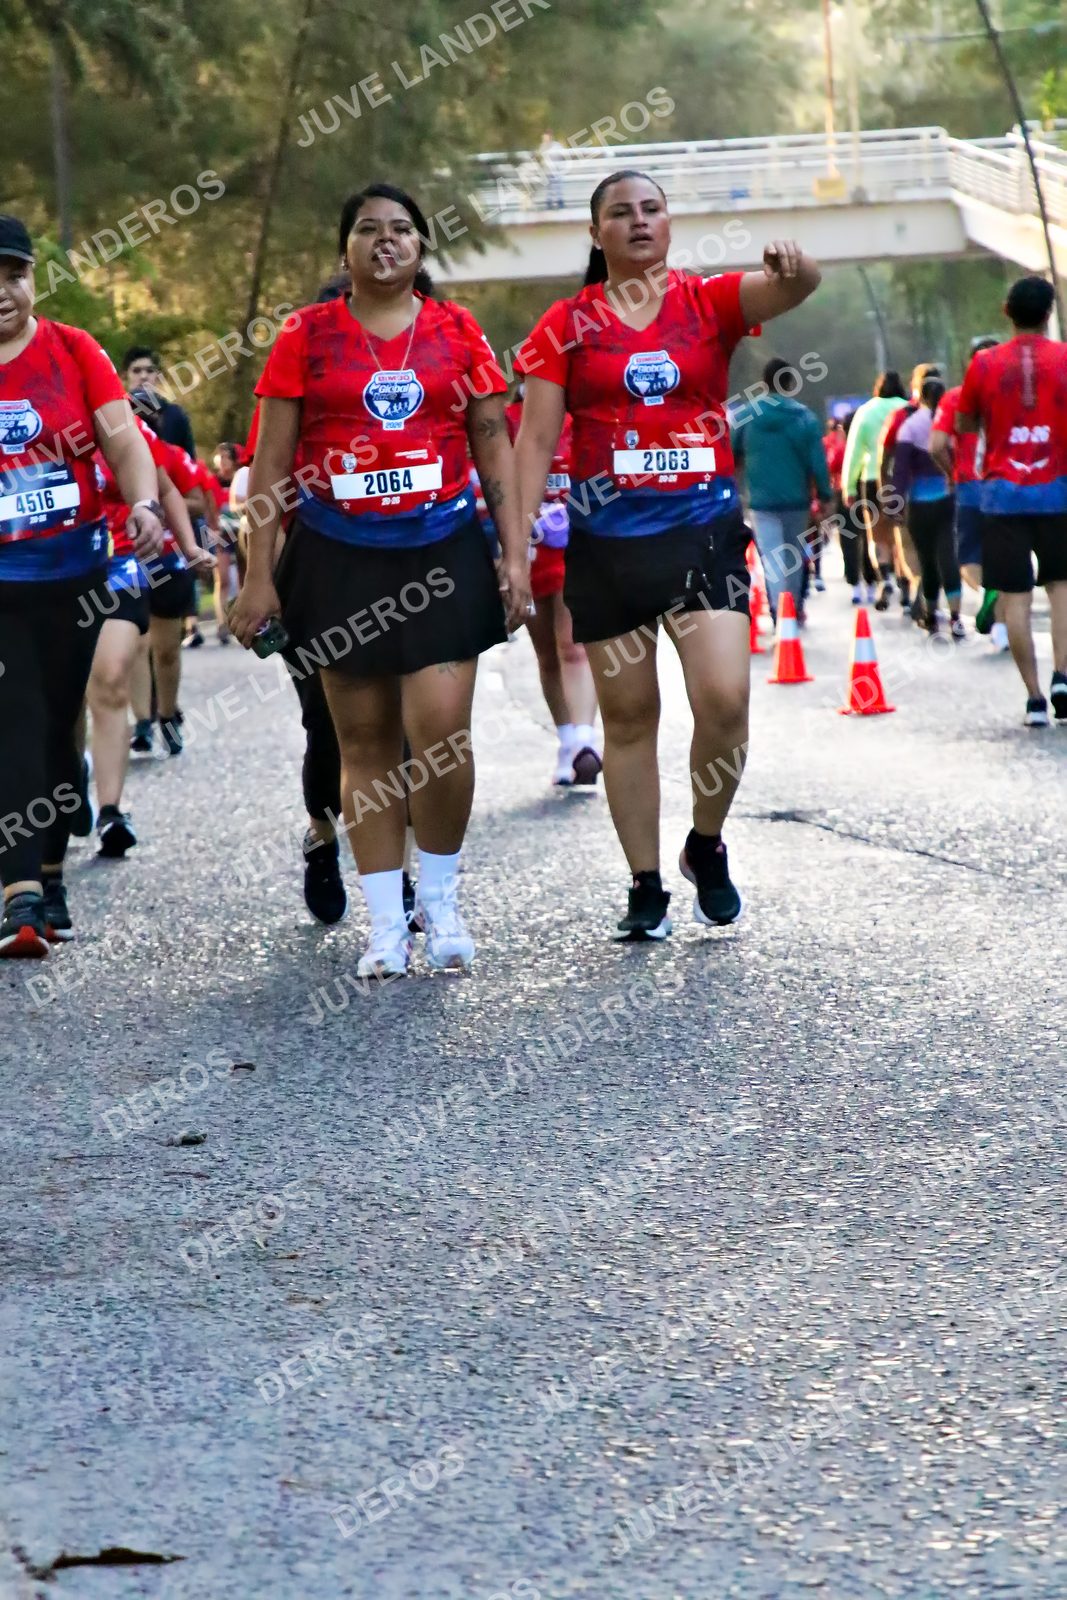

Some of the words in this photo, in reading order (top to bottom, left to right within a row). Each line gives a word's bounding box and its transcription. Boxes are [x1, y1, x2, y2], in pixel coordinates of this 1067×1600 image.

[643, 450, 690, 472] 2063
[363, 468, 413, 496] 2064
[16, 489, 55, 514] 4516
